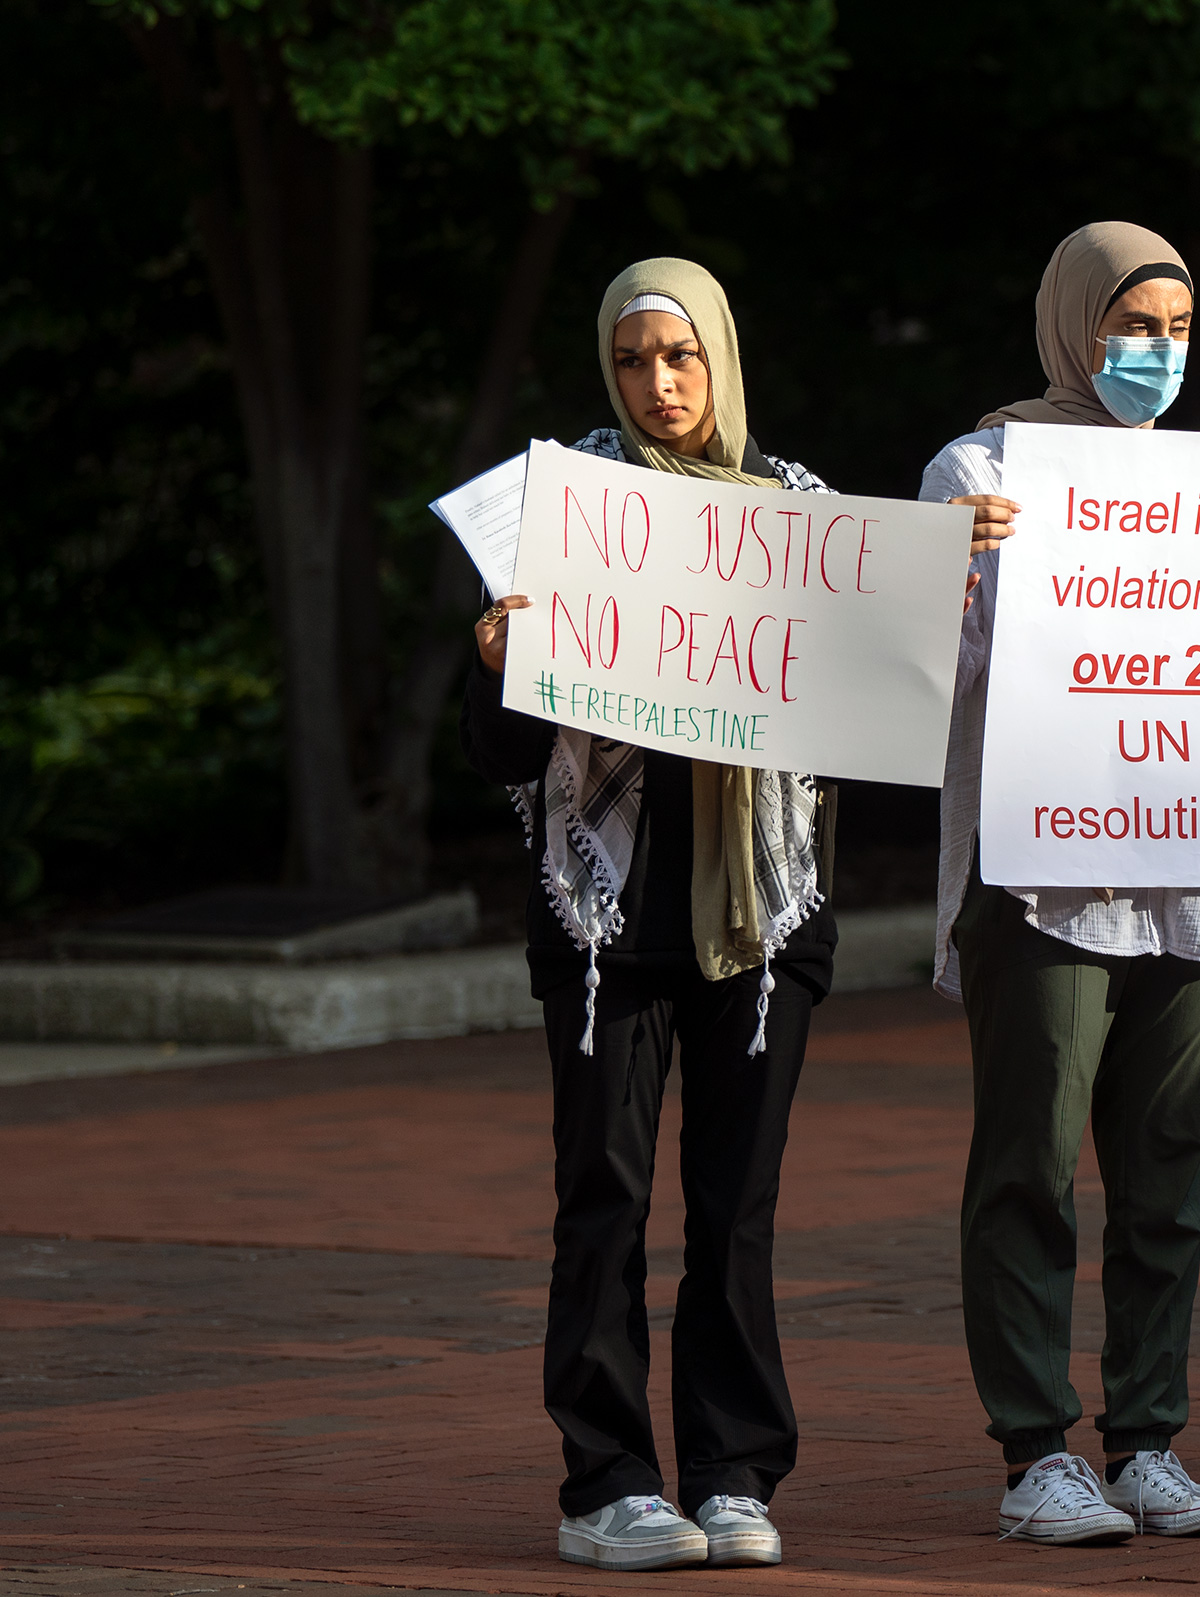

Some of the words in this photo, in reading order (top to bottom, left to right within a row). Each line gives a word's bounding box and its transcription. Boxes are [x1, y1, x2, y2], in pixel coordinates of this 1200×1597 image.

[563, 485, 651, 574] NO
[685, 502, 881, 594] JUSTICE
[1066, 486, 1182, 535] Israel
[551, 590, 620, 670] NO
[656, 604, 808, 704] PEACE
[1072, 652, 1171, 687] over
[533, 671, 770, 751] #FREEPALESTINE
[1118, 719, 1191, 763] UN
